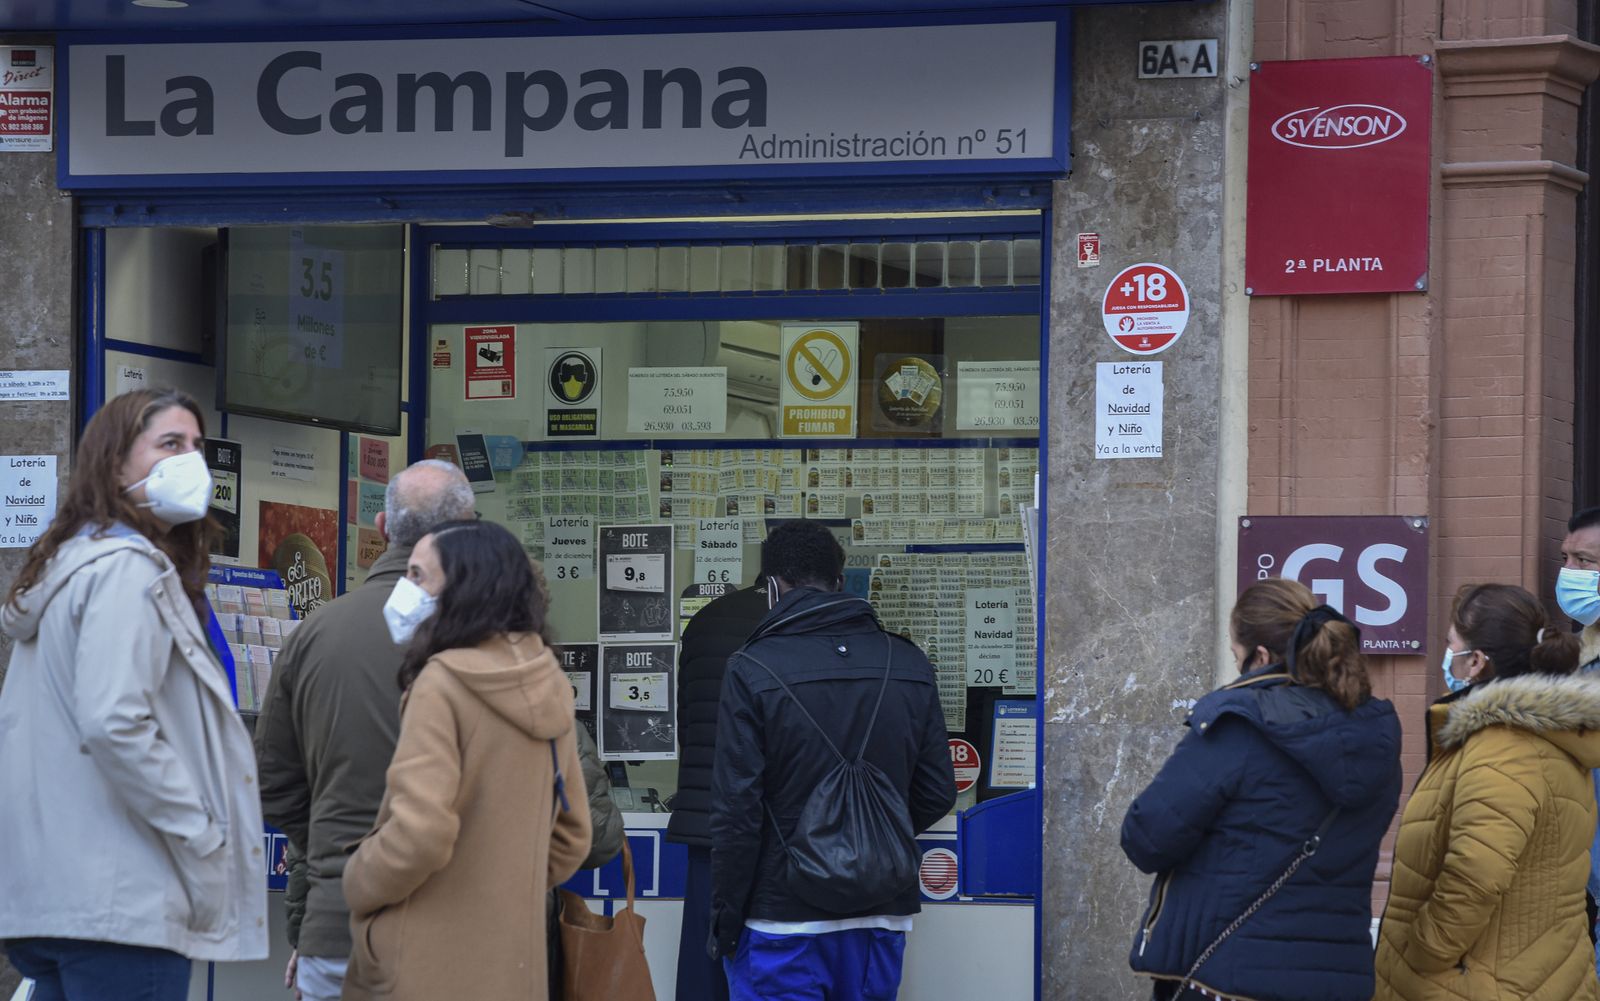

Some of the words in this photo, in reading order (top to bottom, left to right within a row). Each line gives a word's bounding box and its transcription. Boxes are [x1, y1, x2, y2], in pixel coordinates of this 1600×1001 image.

[105, 55, 214, 137] La
[257, 50, 768, 157] Campana
[1285, 115, 1392, 139] SVENSON
[739, 130, 946, 159] Administración
[996, 127, 1029, 155] 51
[1313, 258, 1384, 273] PLANTA
[1120, 272, 1167, 303] +18
[297, 313, 336, 337] Millones
[1113, 363, 1151, 376] Lotería
[663, 387, 694, 398] 75.950
[1122, 384, 1135, 395] de
[663, 405, 693, 415] 69.051
[789, 408, 846, 421] PROHIBIDO
[1108, 403, 1151, 414] Navidad
[644, 421, 674, 431] 26.930
[681, 421, 712, 431] 03.593
[1013, 416, 1039, 426] 03.59
[798, 421, 836, 434] FUMAR
[1107, 424, 1115, 435] y
[1118, 423, 1143, 434] Niño
[1097, 444, 1110, 456] Ya
[1112, 446, 1119, 454] a
[1121, 443, 1131, 454] la
[1133, 444, 1162, 455] venta
[10, 457, 46, 469] Lotería
[19, 477, 32, 488] de
[5, 494, 46, 505] Navidad
[5, 516, 12, 526] y
[15, 514, 38, 525] Niño
[550, 516, 589, 528] Lotería
[699, 519, 739, 531] Lotería
[9, 536, 16, 544] a
[18, 533, 27, 544] la
[551, 537, 587, 546] Jueves
[622, 533, 649, 548] BOTE
[700, 539, 738, 549] Sábado
[557, 566, 566, 580] 3
[569, 566, 580, 580] €
[624, 566, 646, 583] 9,8
[708, 570, 717, 583] 6
[721, 570, 730, 583] €
[699, 584, 726, 596] BOTES
[1280, 543, 1408, 627] GS
[975, 600, 1009, 609] Lotería
[983, 615, 996, 624] de
[974, 629, 1013, 639] Navidad
[1363, 640, 1400, 649] PLANTA
[626, 652, 653, 666] BOTE
[974, 668, 994, 684] 20
[998, 668, 1010, 684] €
[628, 685, 650, 702] 3,5
[950, 745, 969, 762] 18
